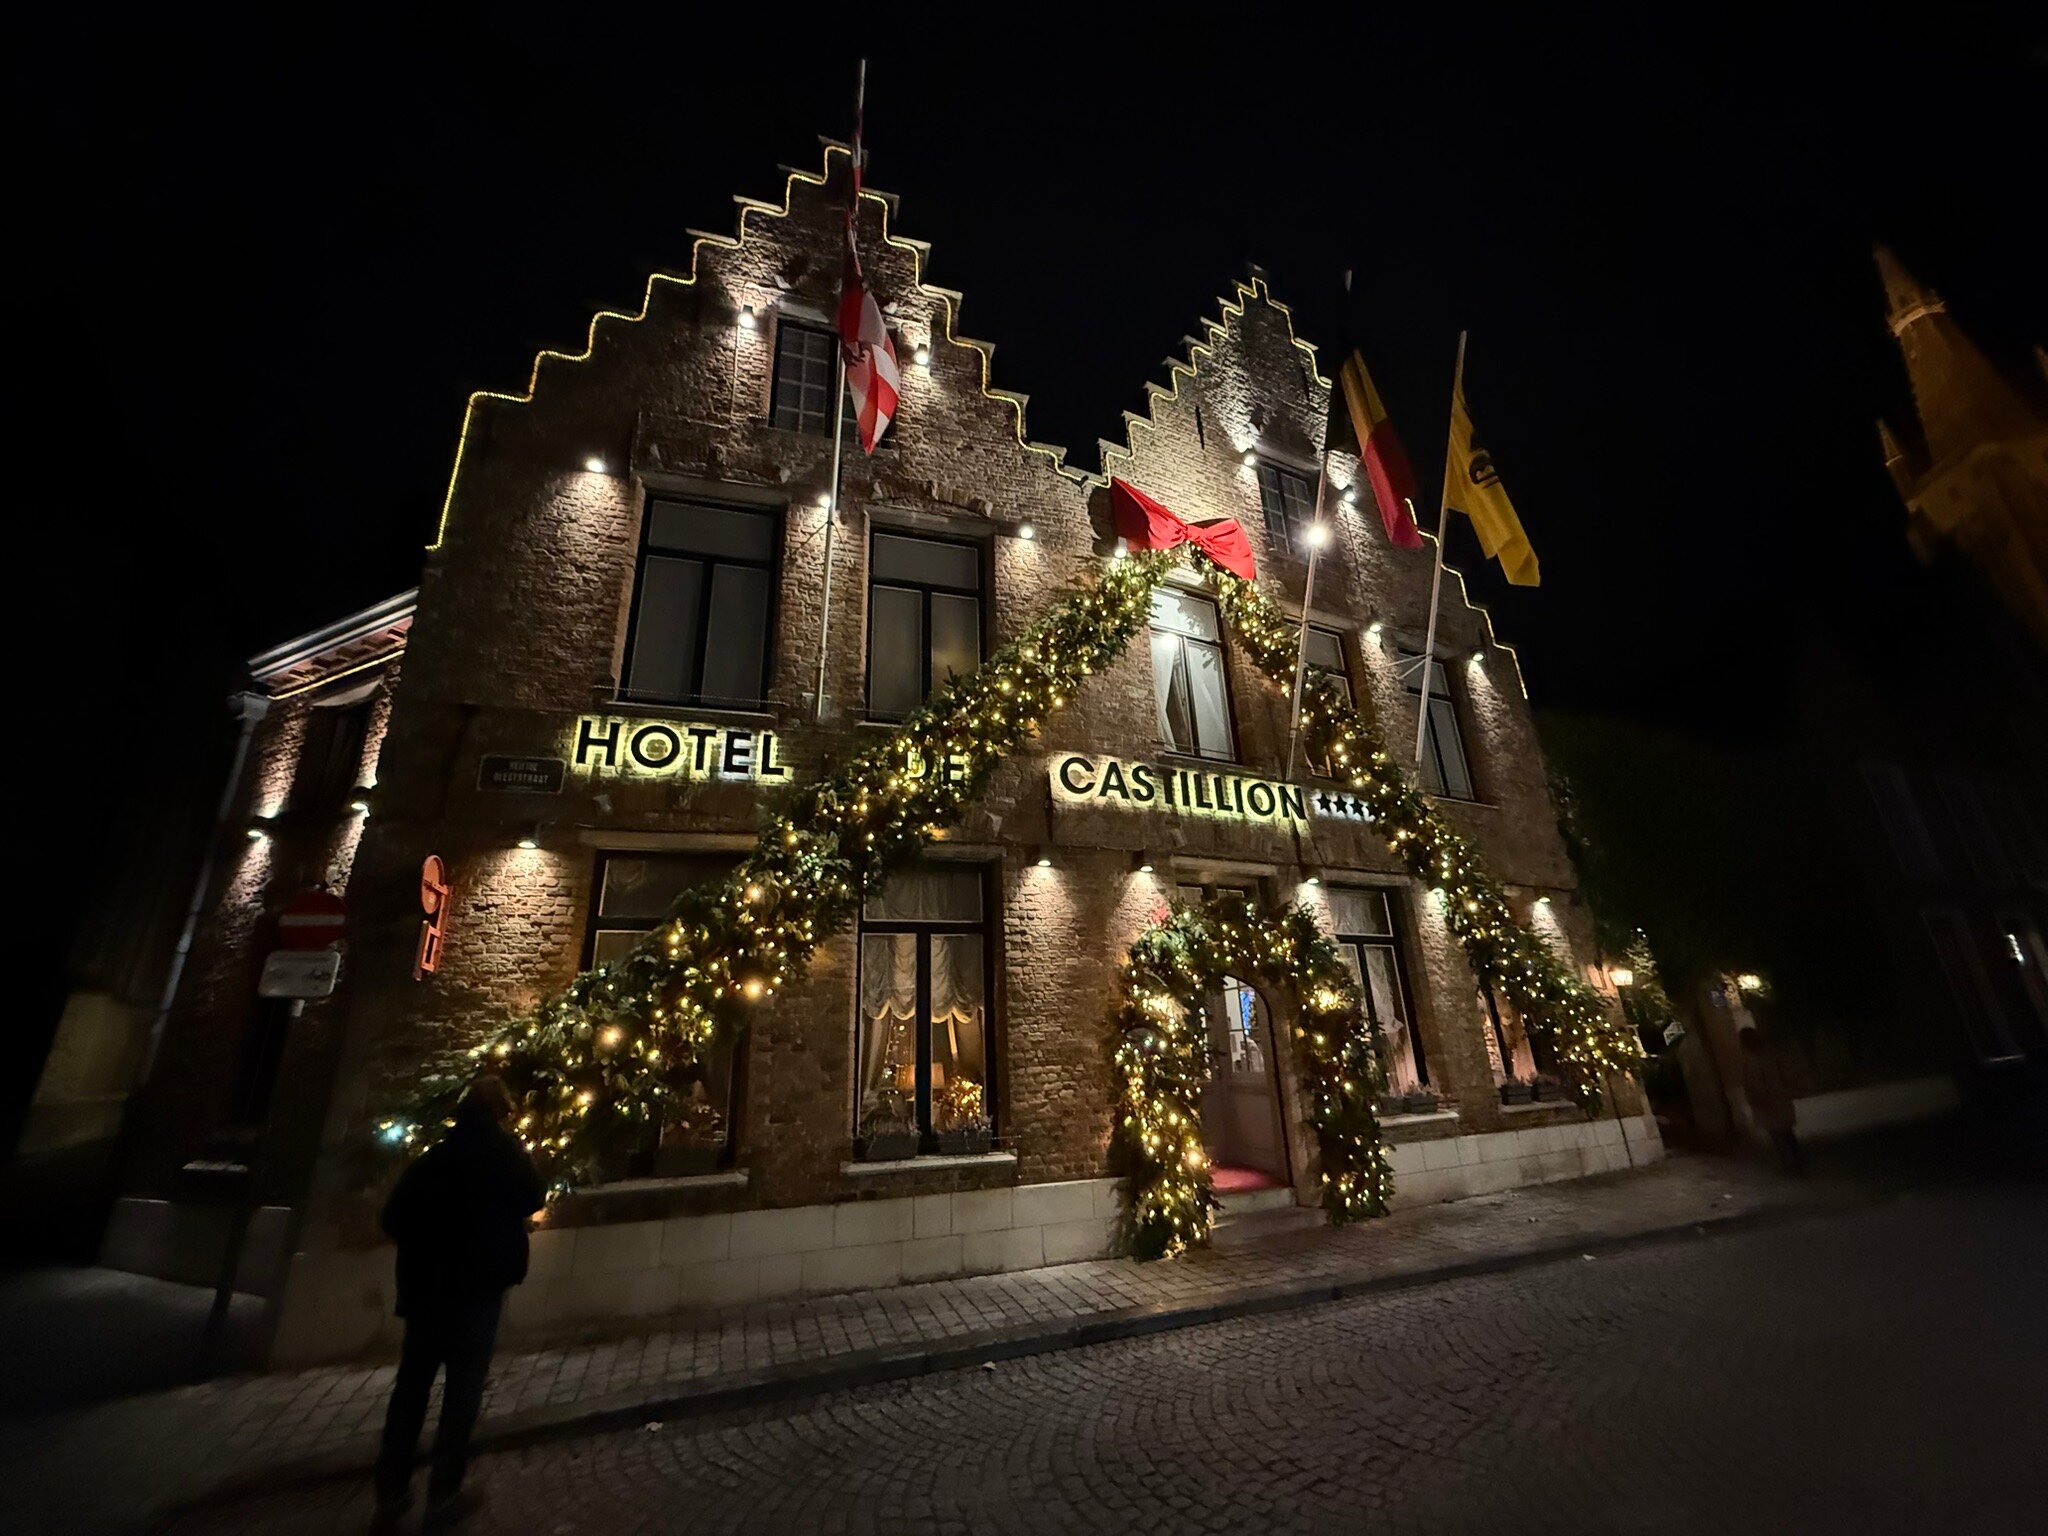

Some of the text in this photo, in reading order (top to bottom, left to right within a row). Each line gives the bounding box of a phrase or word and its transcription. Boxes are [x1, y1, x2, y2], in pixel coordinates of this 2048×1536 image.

[576, 719, 1308, 820] HOTEL DE CASTILLION
